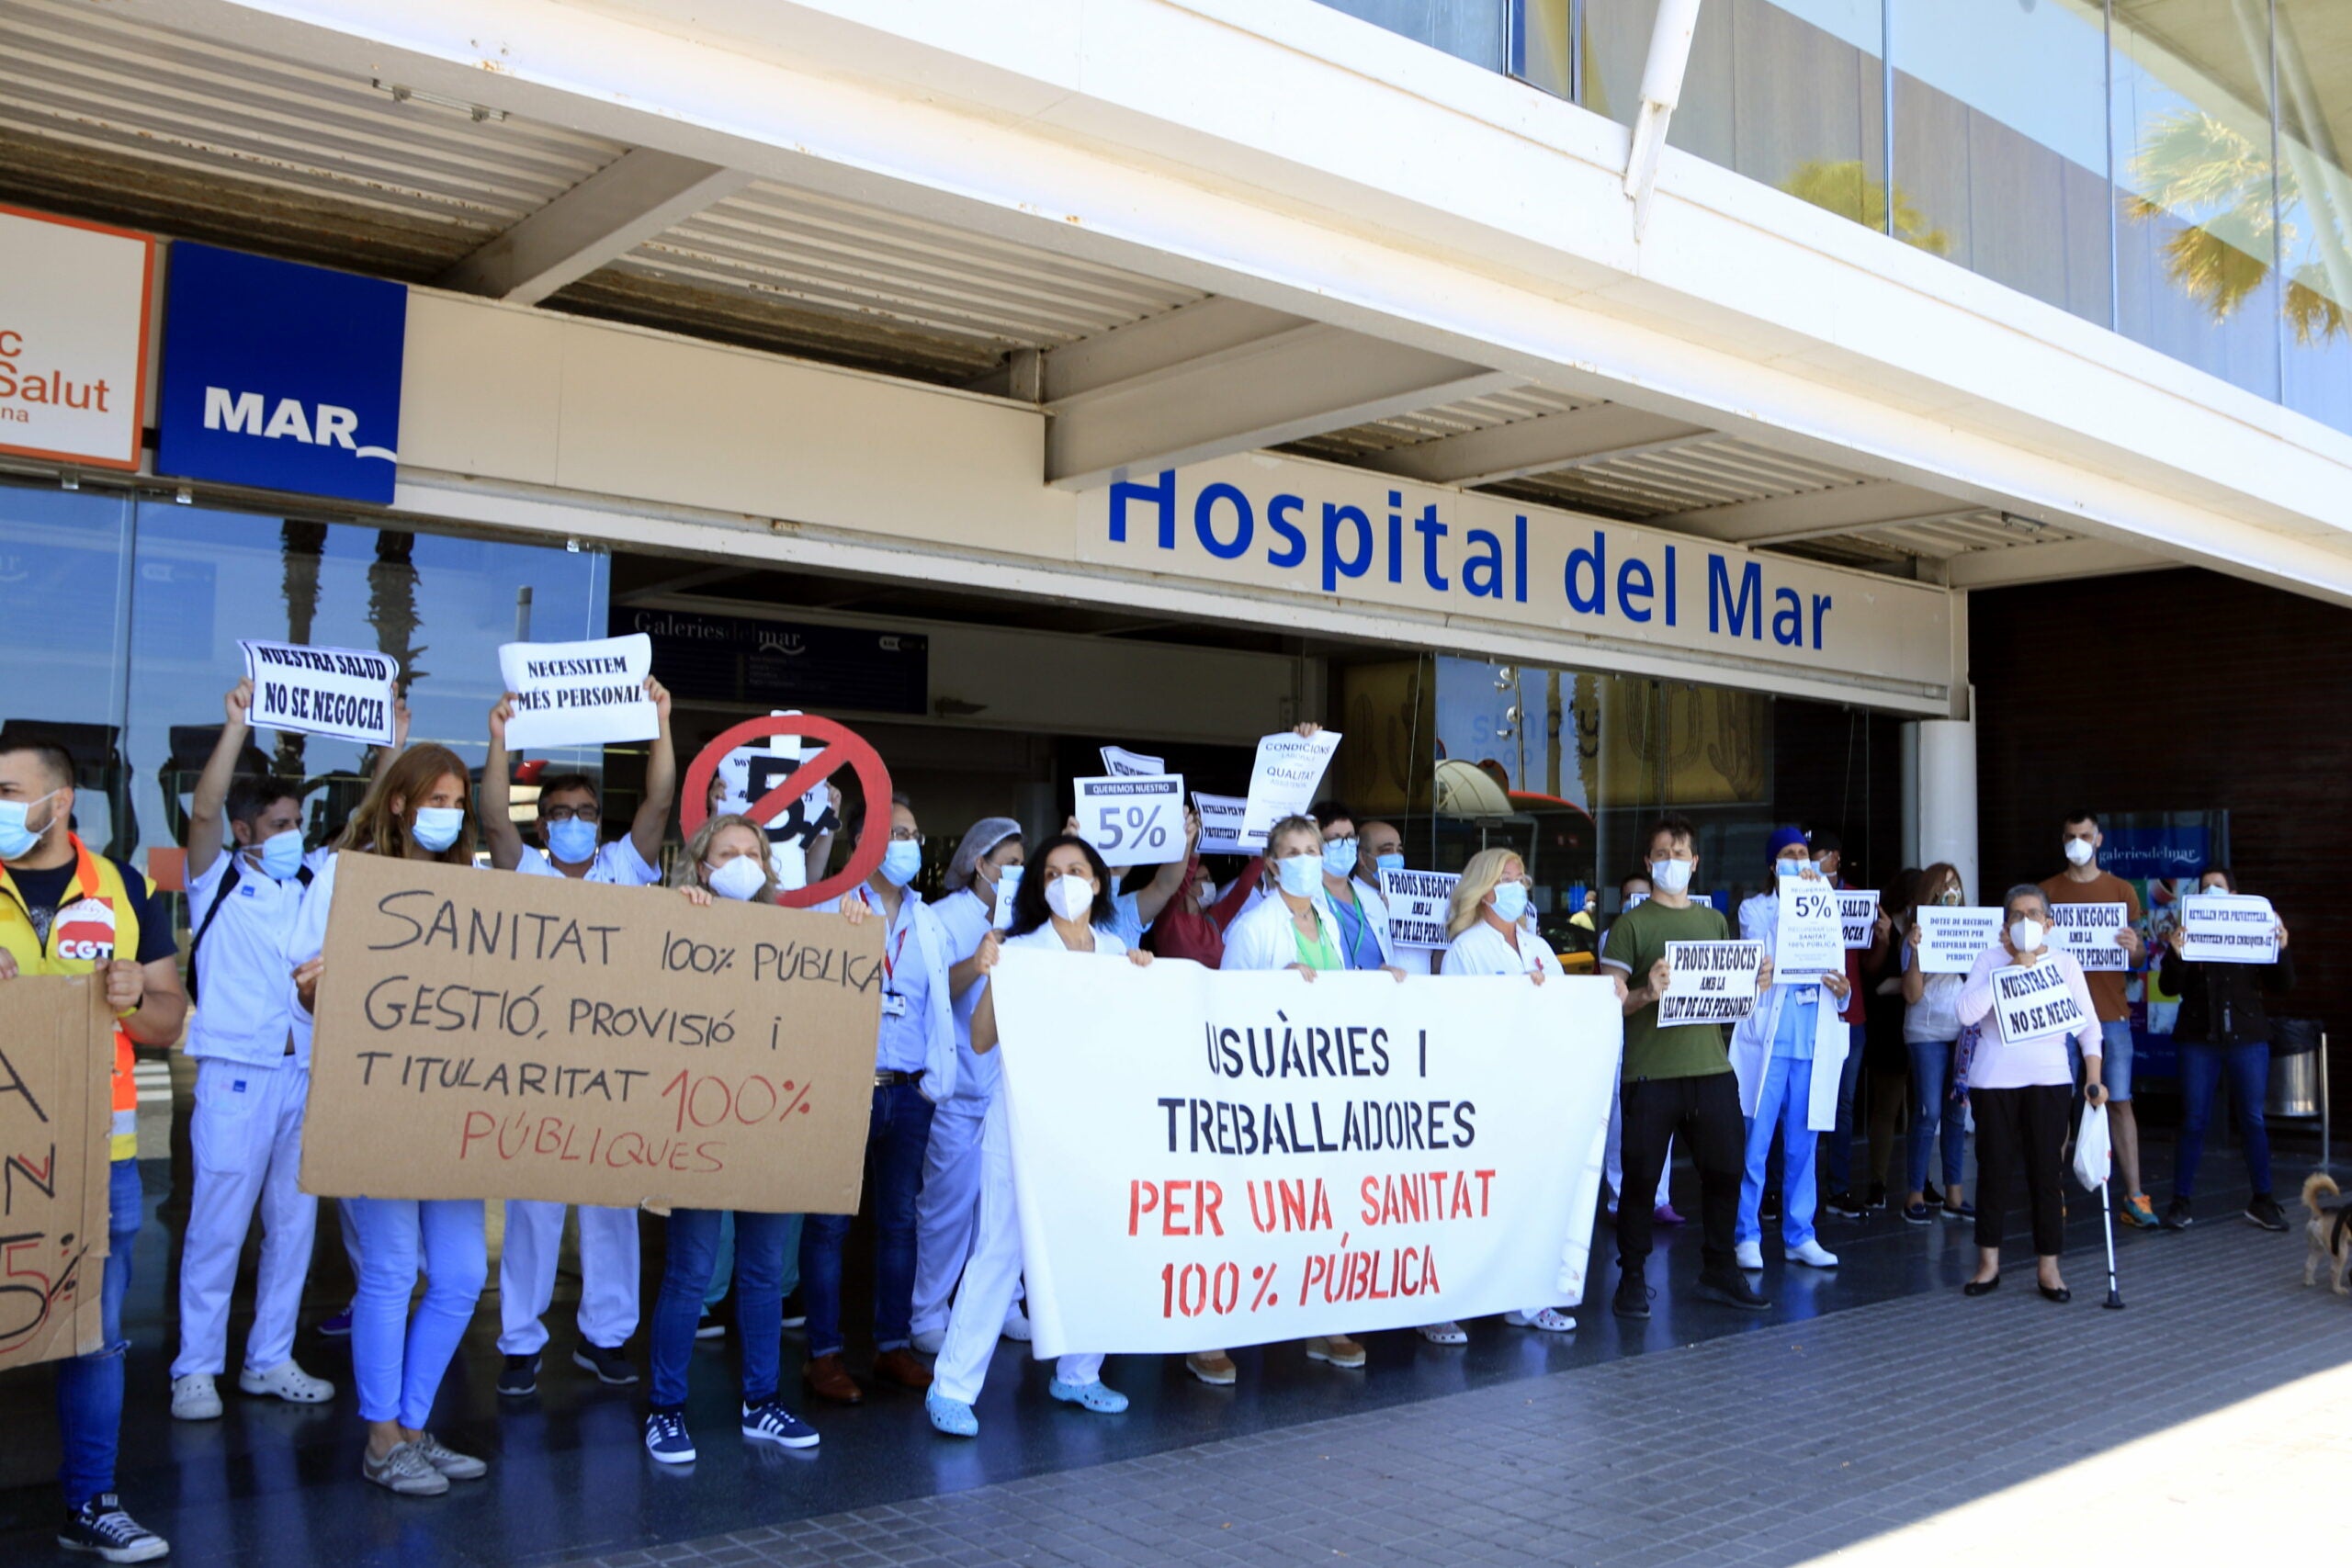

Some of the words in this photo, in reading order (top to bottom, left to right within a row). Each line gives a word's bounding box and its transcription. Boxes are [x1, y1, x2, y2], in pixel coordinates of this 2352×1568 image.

[0, 360, 109, 413] Salut
[204, 386, 358, 450] MAR
[1108, 468, 1528, 603] Hospital
[1565, 530, 1676, 627] del
[1708, 554, 1832, 650] Mar
[259, 647, 338, 674] NUESTRA
[339, 653, 387, 682] SALUD
[527, 656, 628, 678] NECESSITEM
[265, 682, 288, 714] NO
[291, 687, 310, 717] SE
[312, 691, 384, 731] NEGOCIA
[517, 685, 551, 711] MÉS
[557, 686, 643, 709] PERSONAL
[1266, 742, 1330, 755] CONDICIONS
[1266, 766, 1316, 781] QUALITAT
[1093, 784, 1135, 795] QUEREMOS
[1135, 783, 1170, 794] NUESTRO
[1097, 805, 1167, 850] 5%
[1388, 874, 1419, 896] PROUS
[1412, 902, 1424, 915] AMB
[1425, 904, 1432, 916] LA
[1795, 895, 1832, 919] 5%
[1841, 899, 1871, 917] SALUD
[2052, 908, 2074, 927] ROUS
[2076, 908, 2120, 927] NEGOCIS
[368, 890, 620, 964] SANITAT
[662, 931, 737, 976] 100%
[754, 939, 883, 993] PÚBLICA
[1389, 919, 1402, 940] ALUT
[1403, 921, 1411, 941] DE
[1411, 921, 1423, 941] LES
[1423, 923, 1453, 944] PERSON
[1842, 925, 1865, 942] OCIA
[2069, 931, 2083, 942] AMB
[2085, 931, 2092, 942] LA
[59, 939, 114, 960] CGT
[1674, 946, 1710, 970] PROUS
[1711, 946, 1757, 970] NEGOCIS
[2086, 949, 2122, 967] PERSONES
[1700, 976, 1716, 990] AMB
[1716, 976, 1725, 990] LA
[2000, 967, 2047, 999] NUESTRA
[2047, 964, 2064, 989] SA
[365, 976, 549, 1041] GESTIÓ,
[569, 998, 736, 1047] PROVISIÓ
[1663, 997, 1686, 1019] SALUT
[1684, 997, 1698, 1018] DE
[1696, 997, 1713, 1018] LES
[1712, 997, 1753, 1018] PERSONES
[2009, 1010, 2029, 1034] NO
[2030, 1007, 2046, 1030] SE
[1205, 1009, 1389, 1078] USUÀRIES
[1418, 1029, 1428, 1077] I
[357, 1052, 650, 1102] TITULARITAT
[662, 1068, 811, 1132] 100%
[1158, 1098, 1476, 1156] TREBALLADORES
[459, 1110, 729, 1174] PÚBLIQUES
[1128, 1179, 1224, 1236] PER
[1246, 1177, 1333, 1233] UNA
[1360, 1168, 1497, 1226] SANITAT
[1298, 1230, 1441, 1307] PÚBLICA
